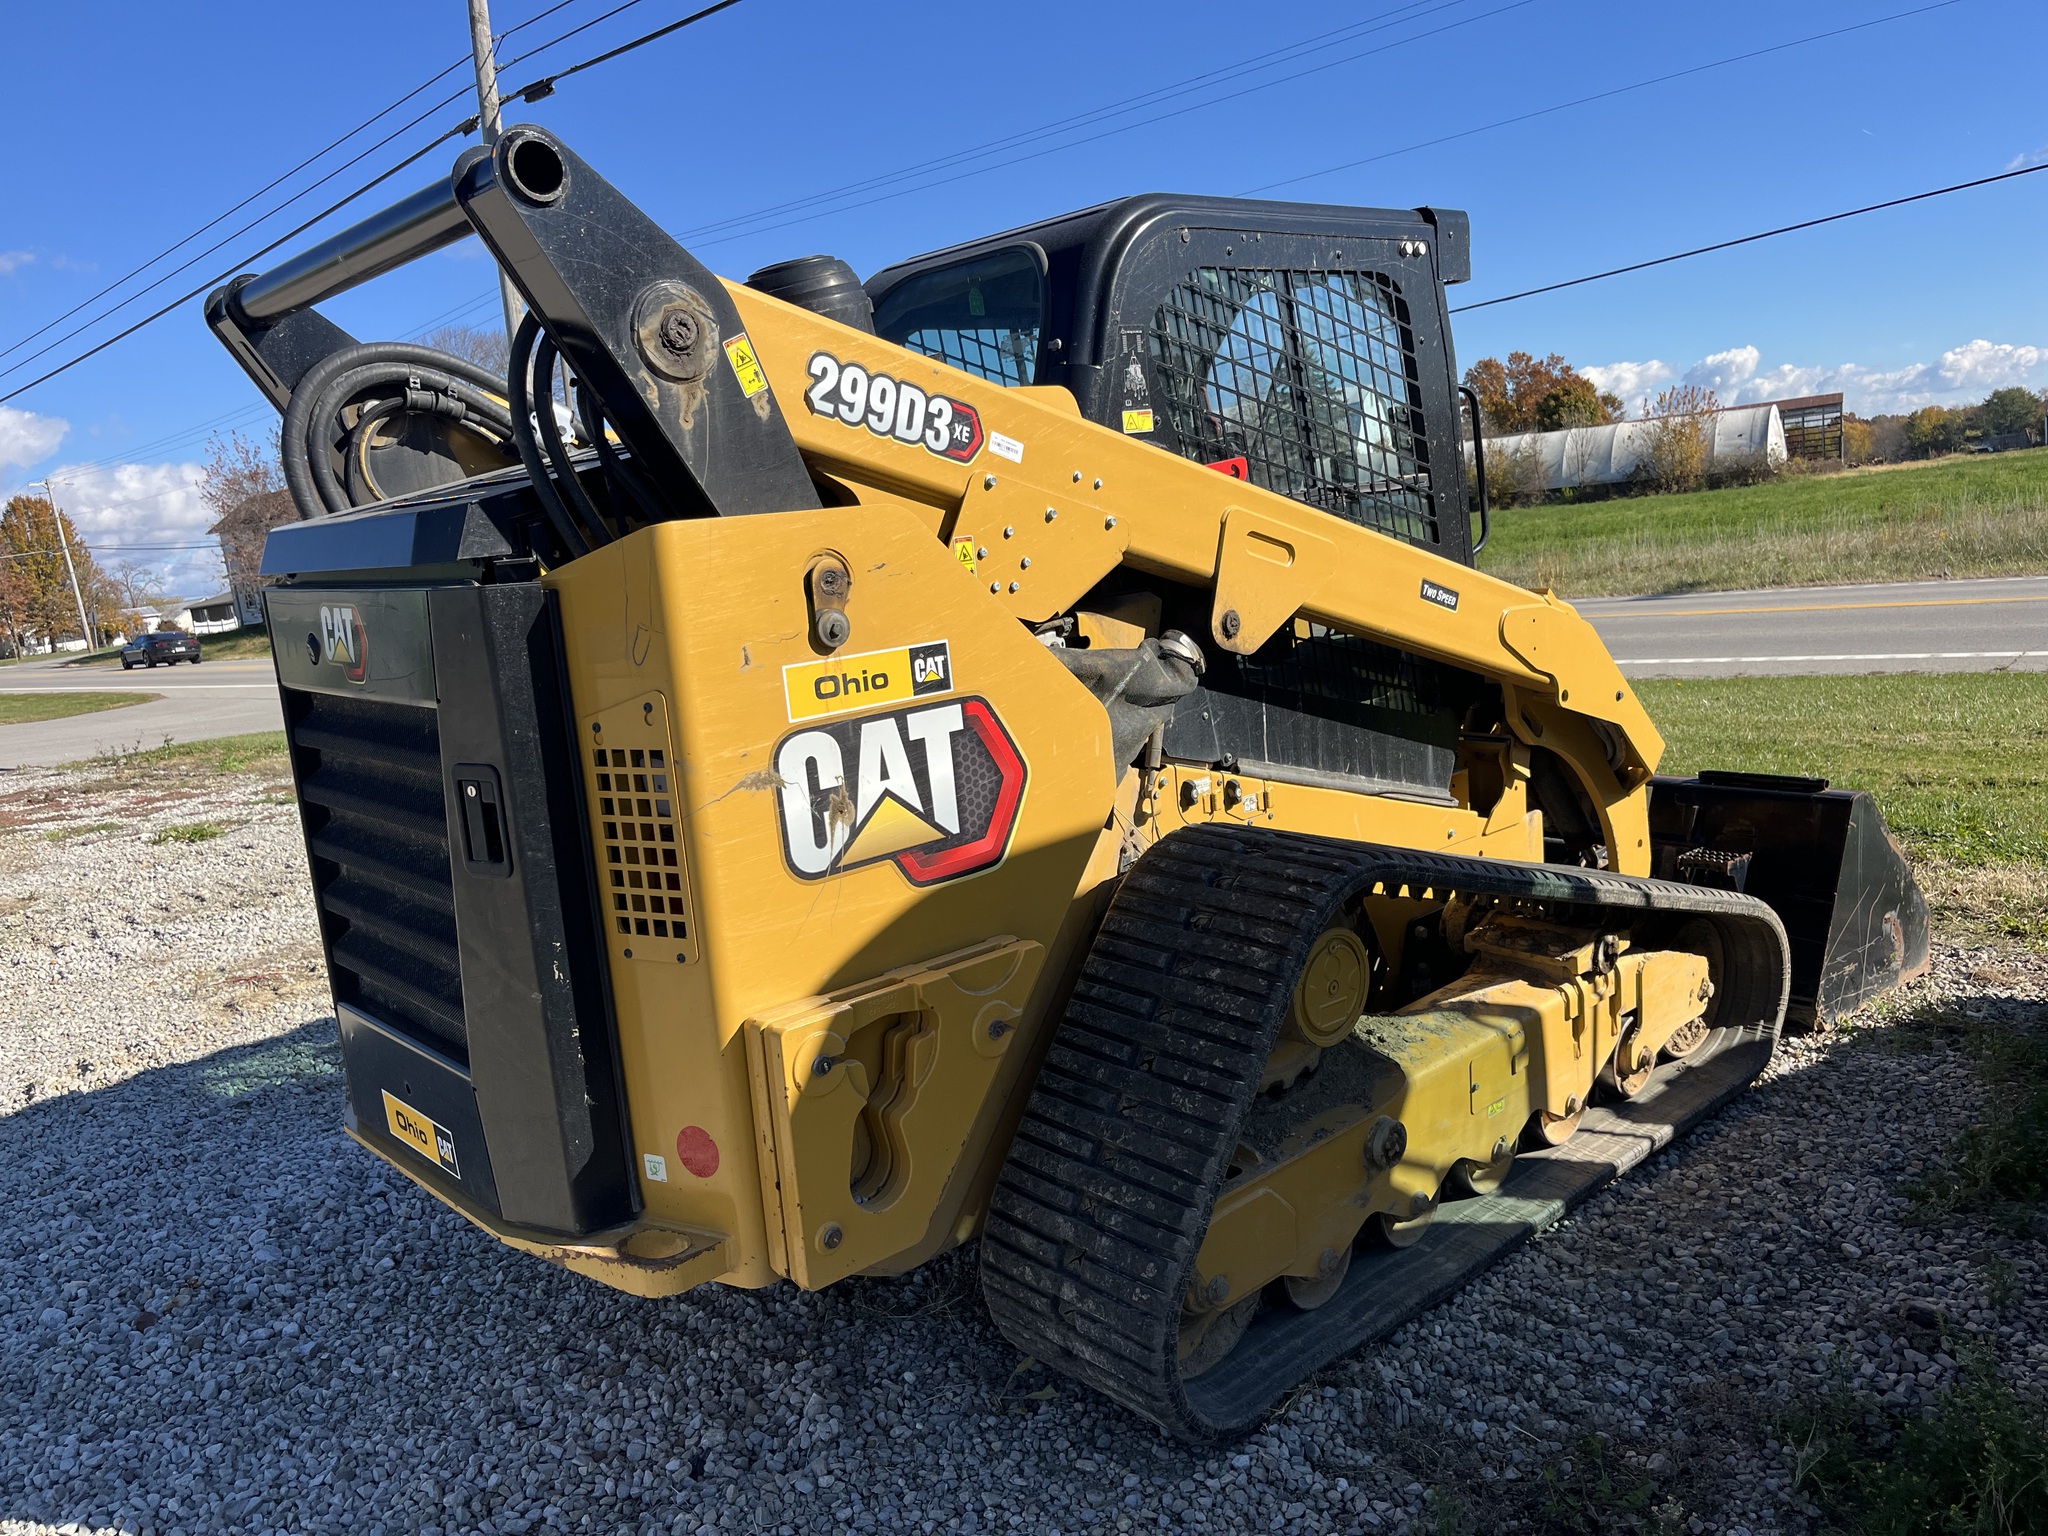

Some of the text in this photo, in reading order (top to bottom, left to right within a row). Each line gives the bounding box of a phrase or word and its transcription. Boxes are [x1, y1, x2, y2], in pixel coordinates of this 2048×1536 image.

[808, 355, 971, 452] 299D3 XE
[320, 605, 356, 664] CAT
[814, 655, 946, 700] Ohio CAT
[778, 703, 964, 874] CAT
[395, 1109, 454, 1164] Ohio CAT
